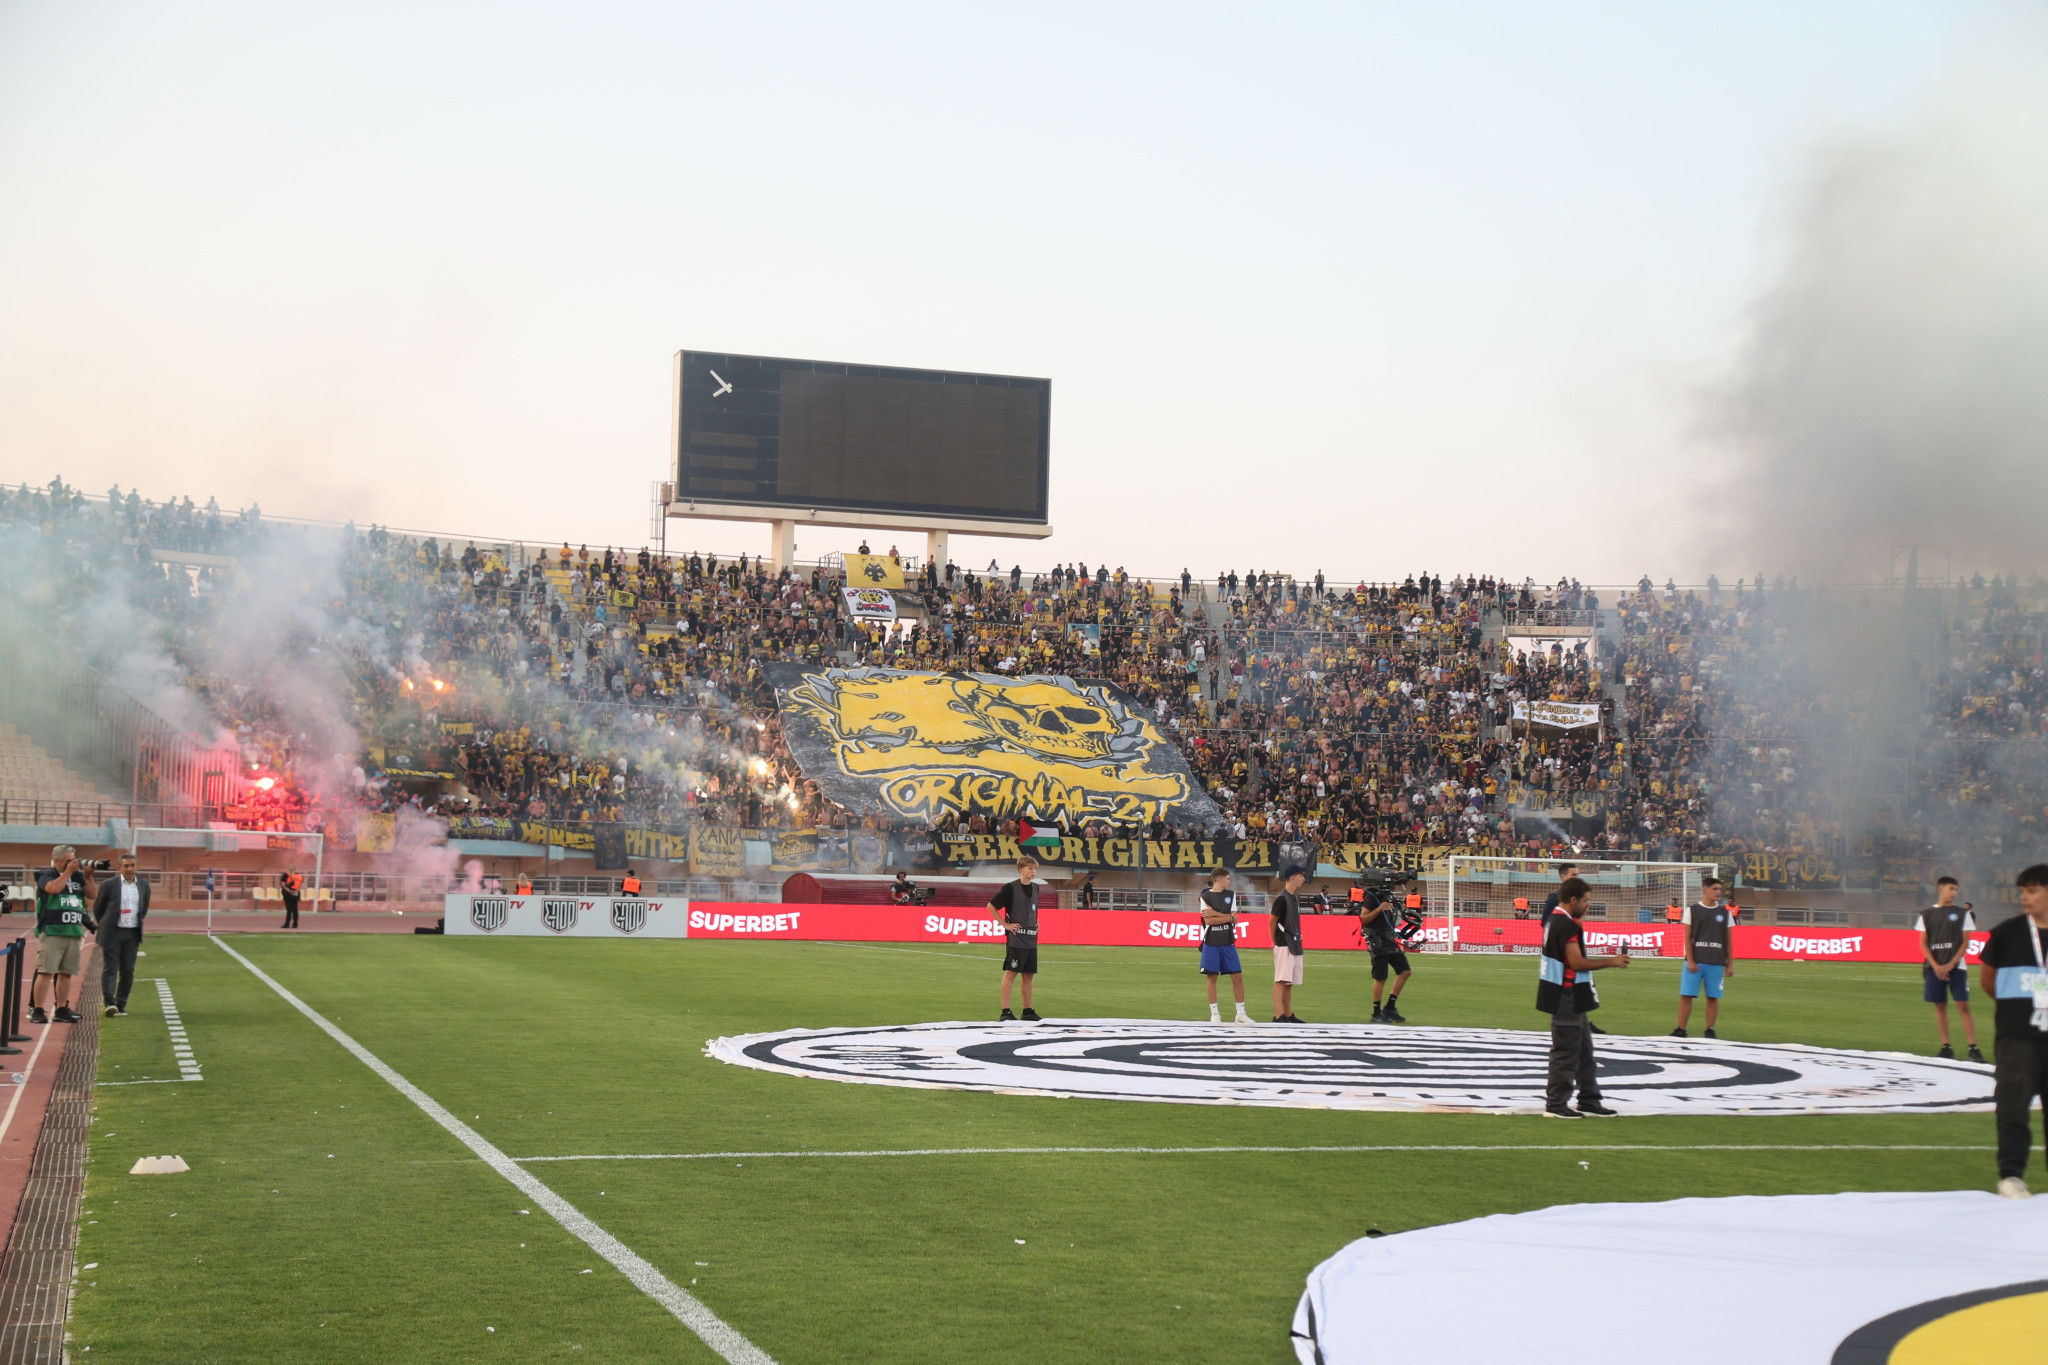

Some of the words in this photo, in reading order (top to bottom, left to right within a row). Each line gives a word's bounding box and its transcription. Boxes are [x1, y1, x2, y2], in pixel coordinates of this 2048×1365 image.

[1370, 844, 1400, 852] SINCE
[1406, 845, 1424, 854] 1989
[1235, 841, 1272, 868] 21
[510, 901, 525, 909] TV
[579, 902, 594, 910] TV
[648, 903, 663, 911] TV
[690, 910, 800, 933] SUPERBET
[925, 915, 1006, 937] SUPERB
[1148, 920, 1249, 941] SUPET
[1582, 931, 1664, 947] UPERBET
[1770, 934, 1862, 954] SUPERBET
[1460, 943, 1504, 952] SUPERBET
[1512, 945, 1542, 954] SUPER
[1616, 947, 1659, 957] SPERBET
